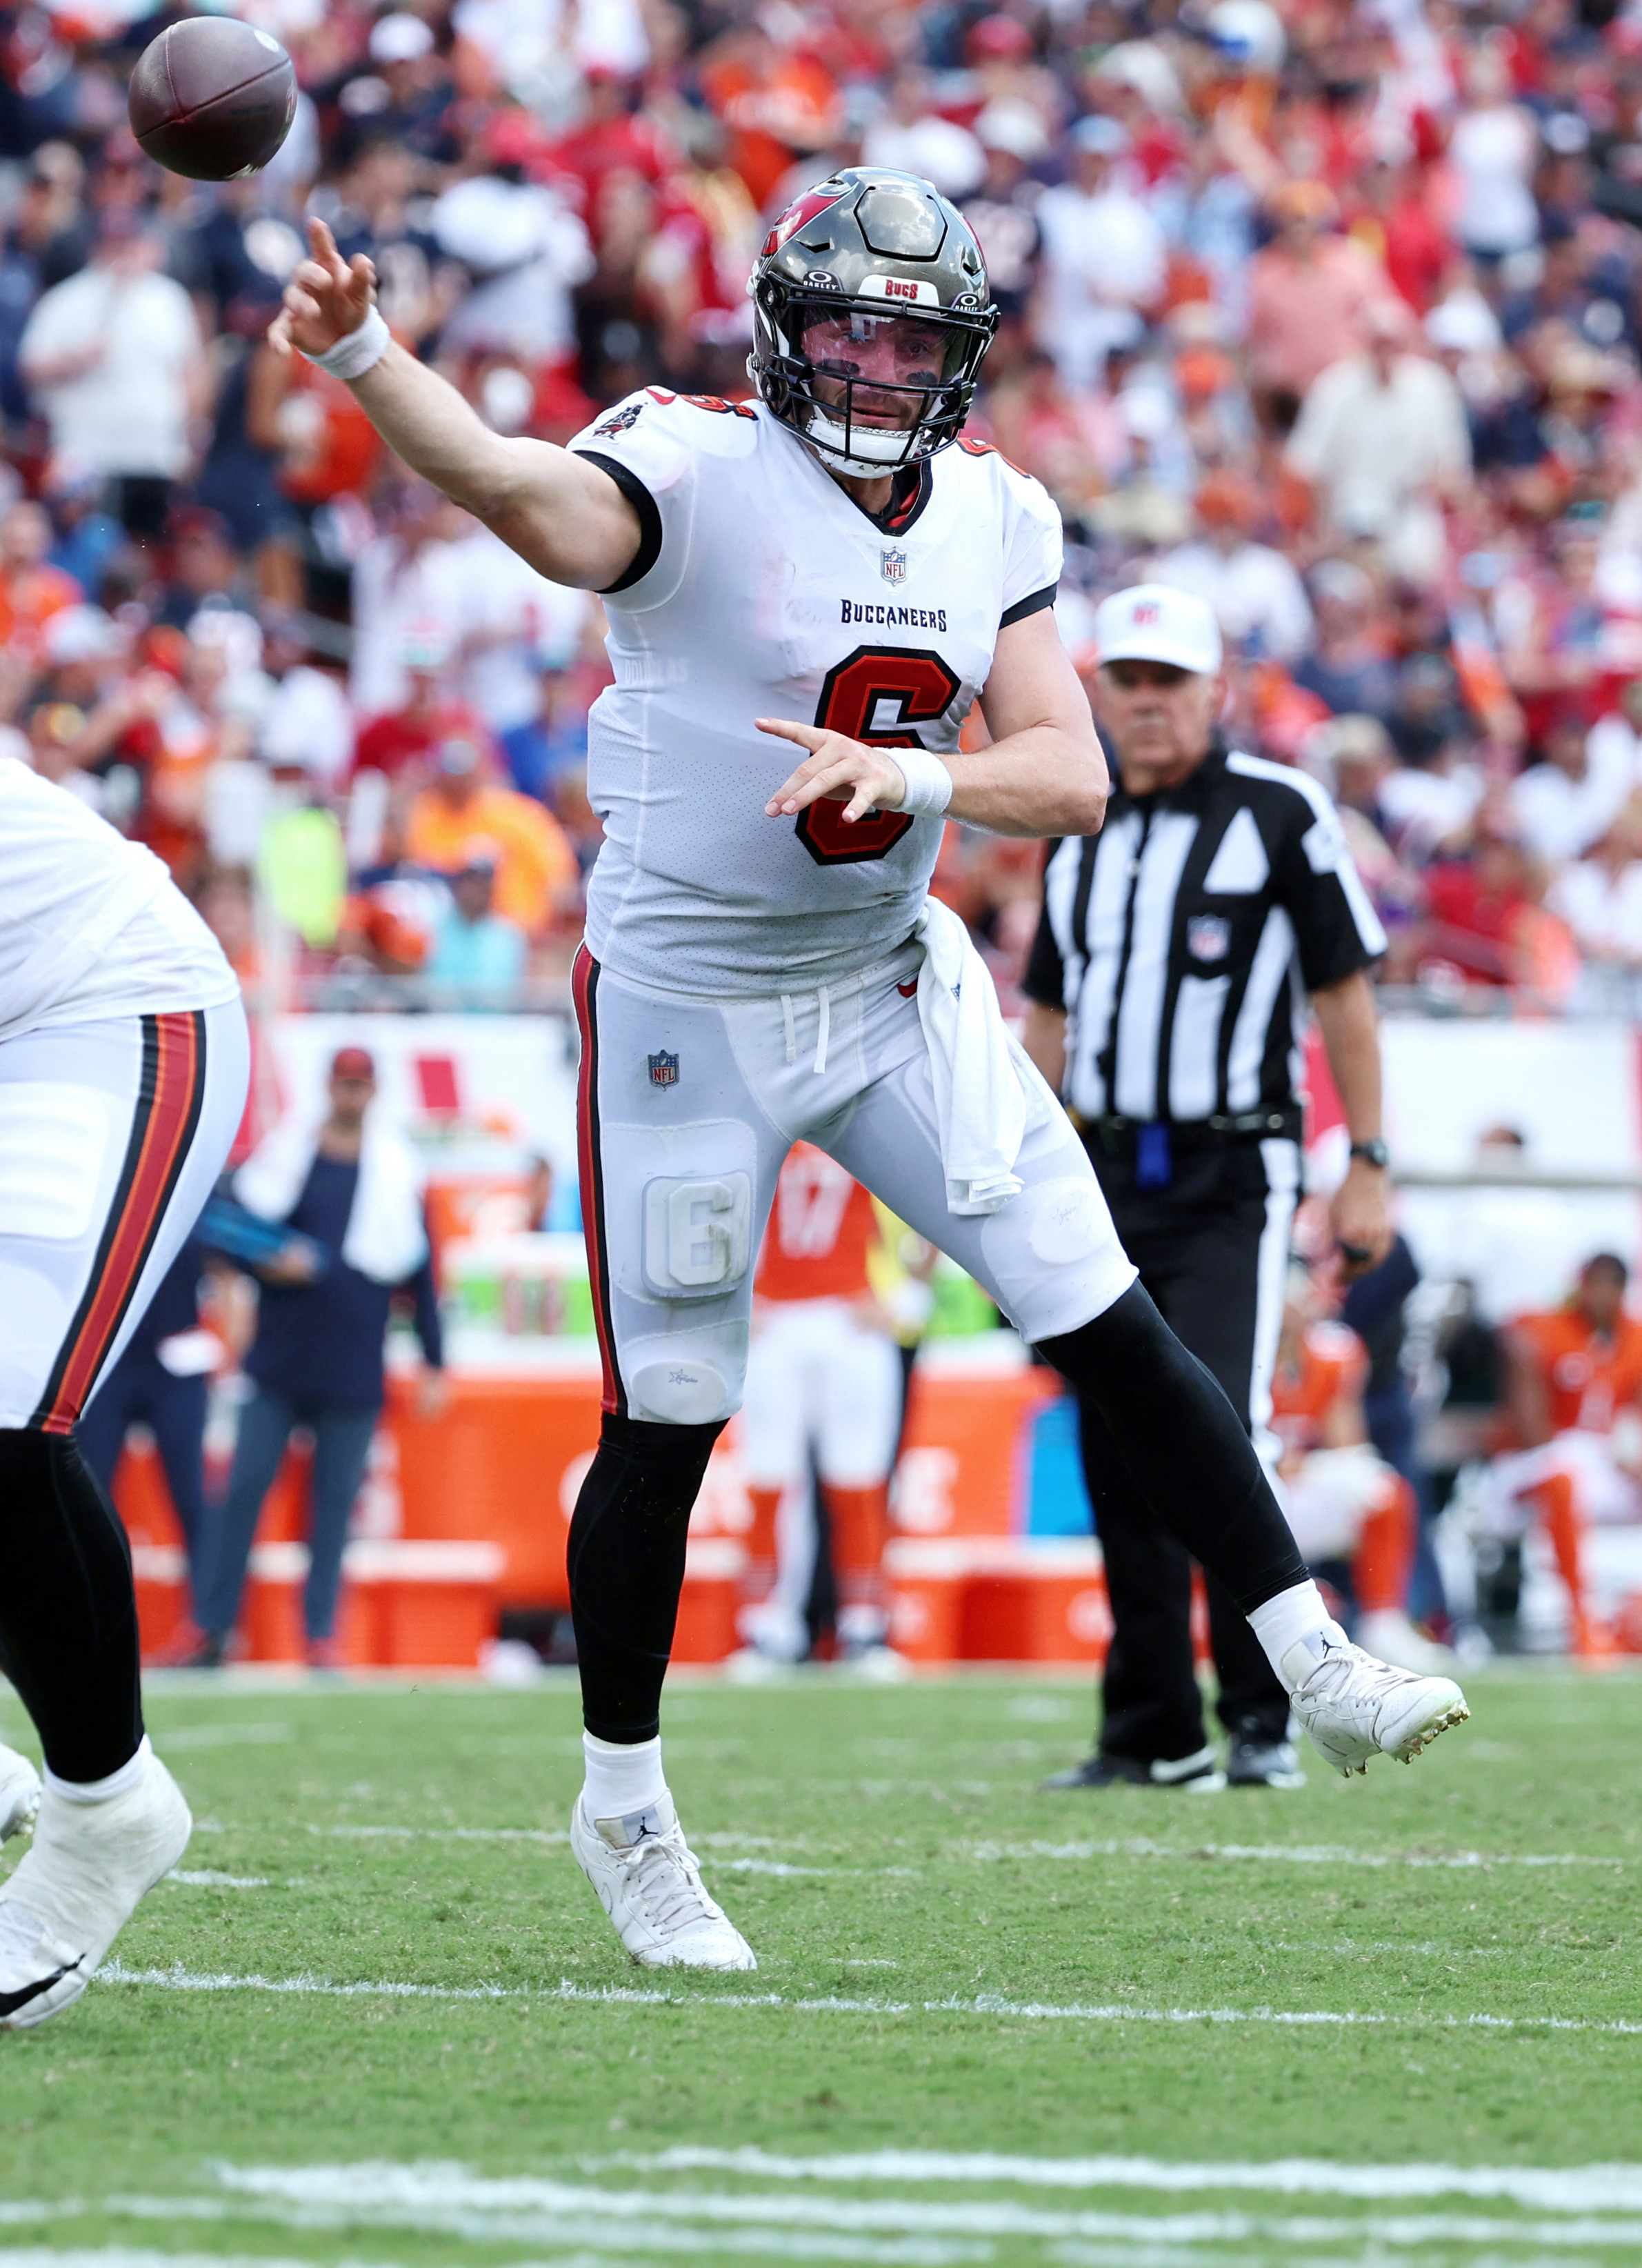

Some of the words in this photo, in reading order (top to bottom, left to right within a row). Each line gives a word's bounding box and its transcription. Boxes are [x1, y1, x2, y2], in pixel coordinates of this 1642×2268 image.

[803, 280, 838, 290] OAKLEY
[840, 599, 948, 633] BUCCANEERS
[794, 644, 962, 866] 6
[653, 1068, 674, 1083] NFL
[668, 1181, 733, 1286] 6
